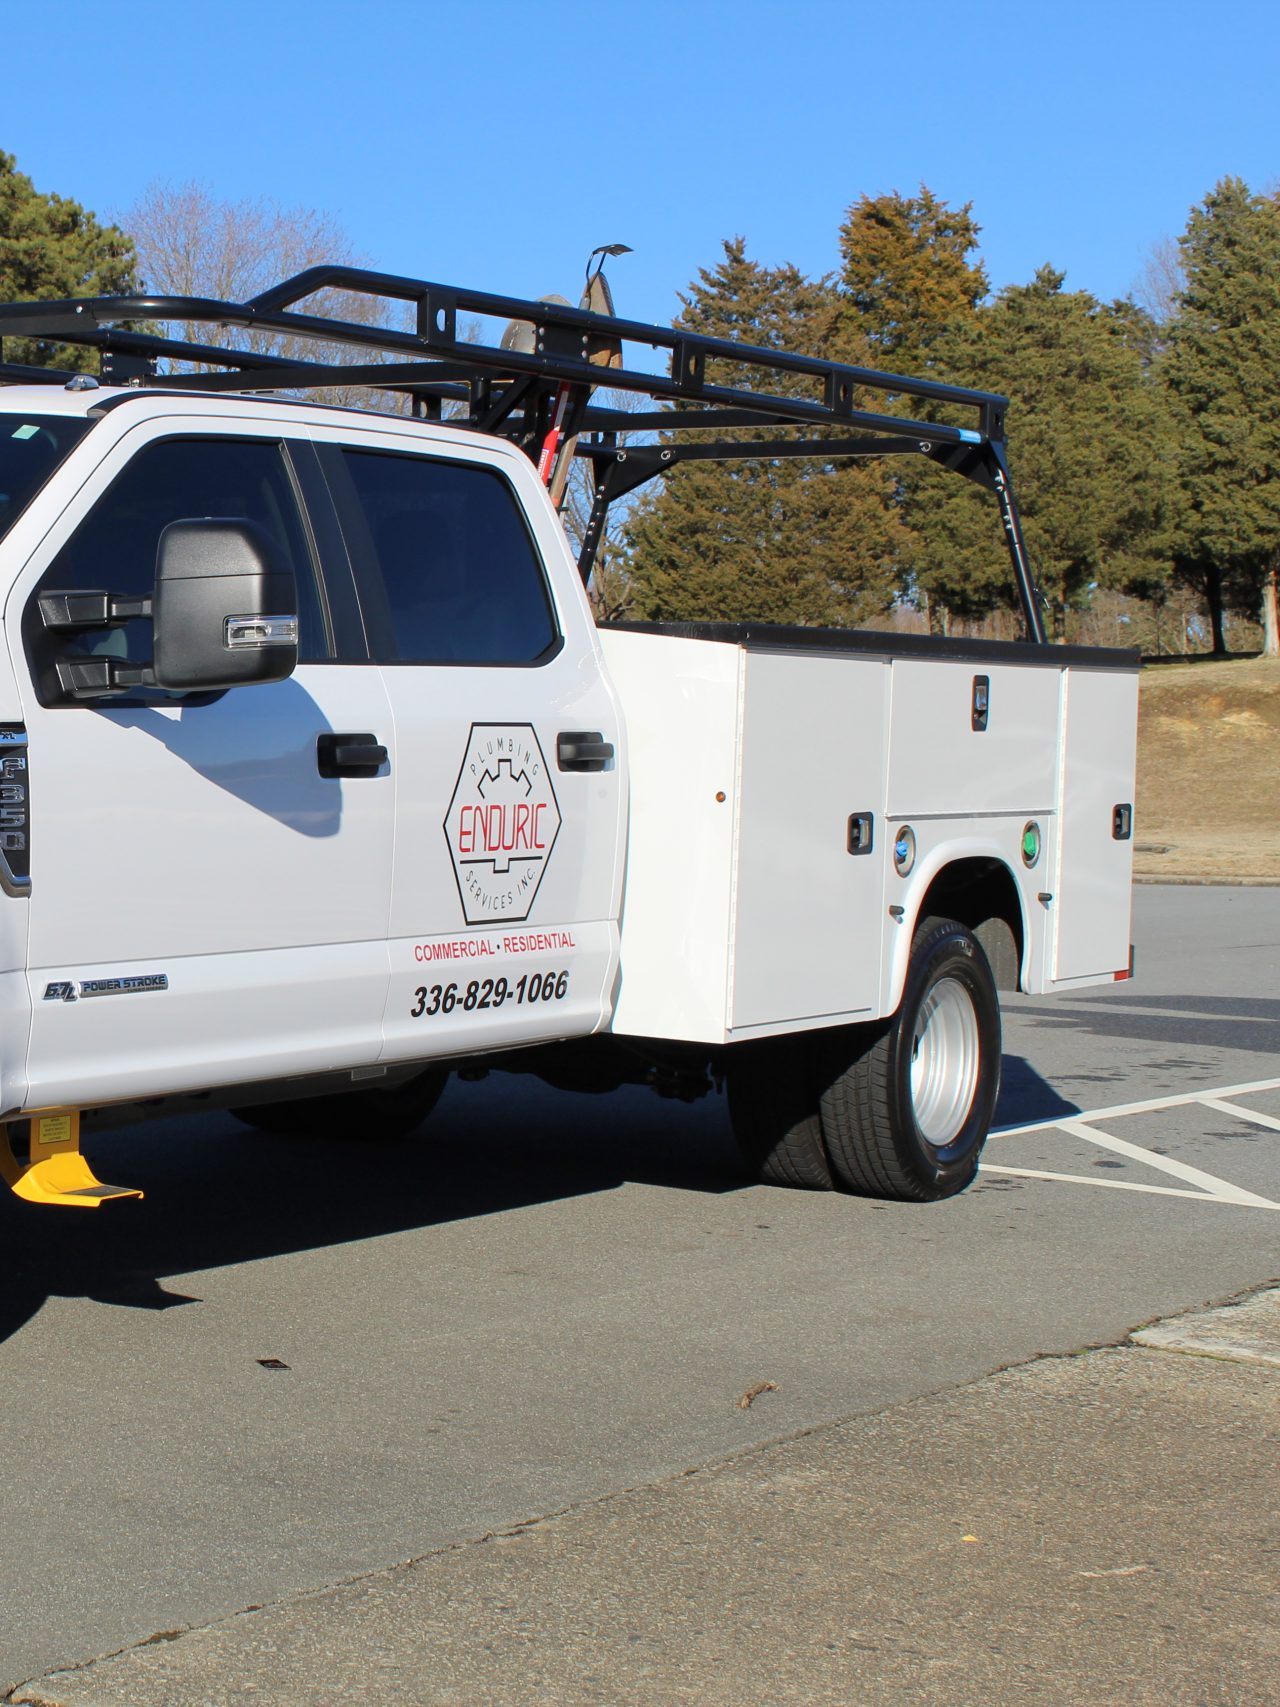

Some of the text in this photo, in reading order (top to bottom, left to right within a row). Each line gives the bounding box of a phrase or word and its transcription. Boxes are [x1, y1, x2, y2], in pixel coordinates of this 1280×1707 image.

[470, 737, 539, 777] PLUMBING
[458, 803, 547, 852] ENDURIC
[466, 867, 536, 910] SERVICES INC.
[414, 932, 576, 962] COMMERCIAL RESIDENTIAL
[83, 981, 121, 993] POWER
[123, 975, 166, 989] STROKE
[410, 970, 570, 1018] 336-829-1066
